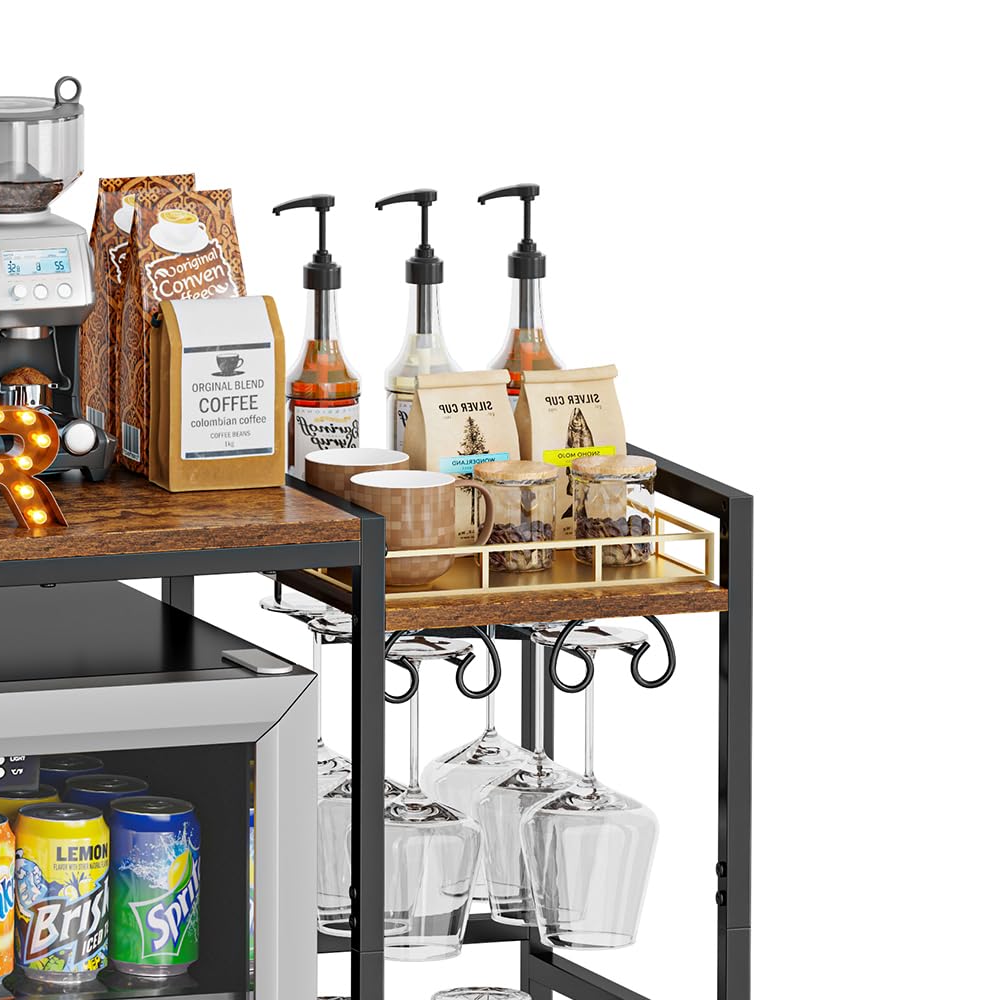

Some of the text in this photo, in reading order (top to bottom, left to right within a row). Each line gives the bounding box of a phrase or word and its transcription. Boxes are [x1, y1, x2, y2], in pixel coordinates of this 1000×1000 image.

[176, 247, 218, 274] original
[159, 265, 225, 297] Conven
[191, 379, 265, 393] ORGINAL BLEND
[199, 394, 259, 413] COFFEE
[190, 414, 267, 428] colombian coffee
[210, 430, 251, 439] COFFEE BEANS
[56, 842, 108, 862] LEMON
